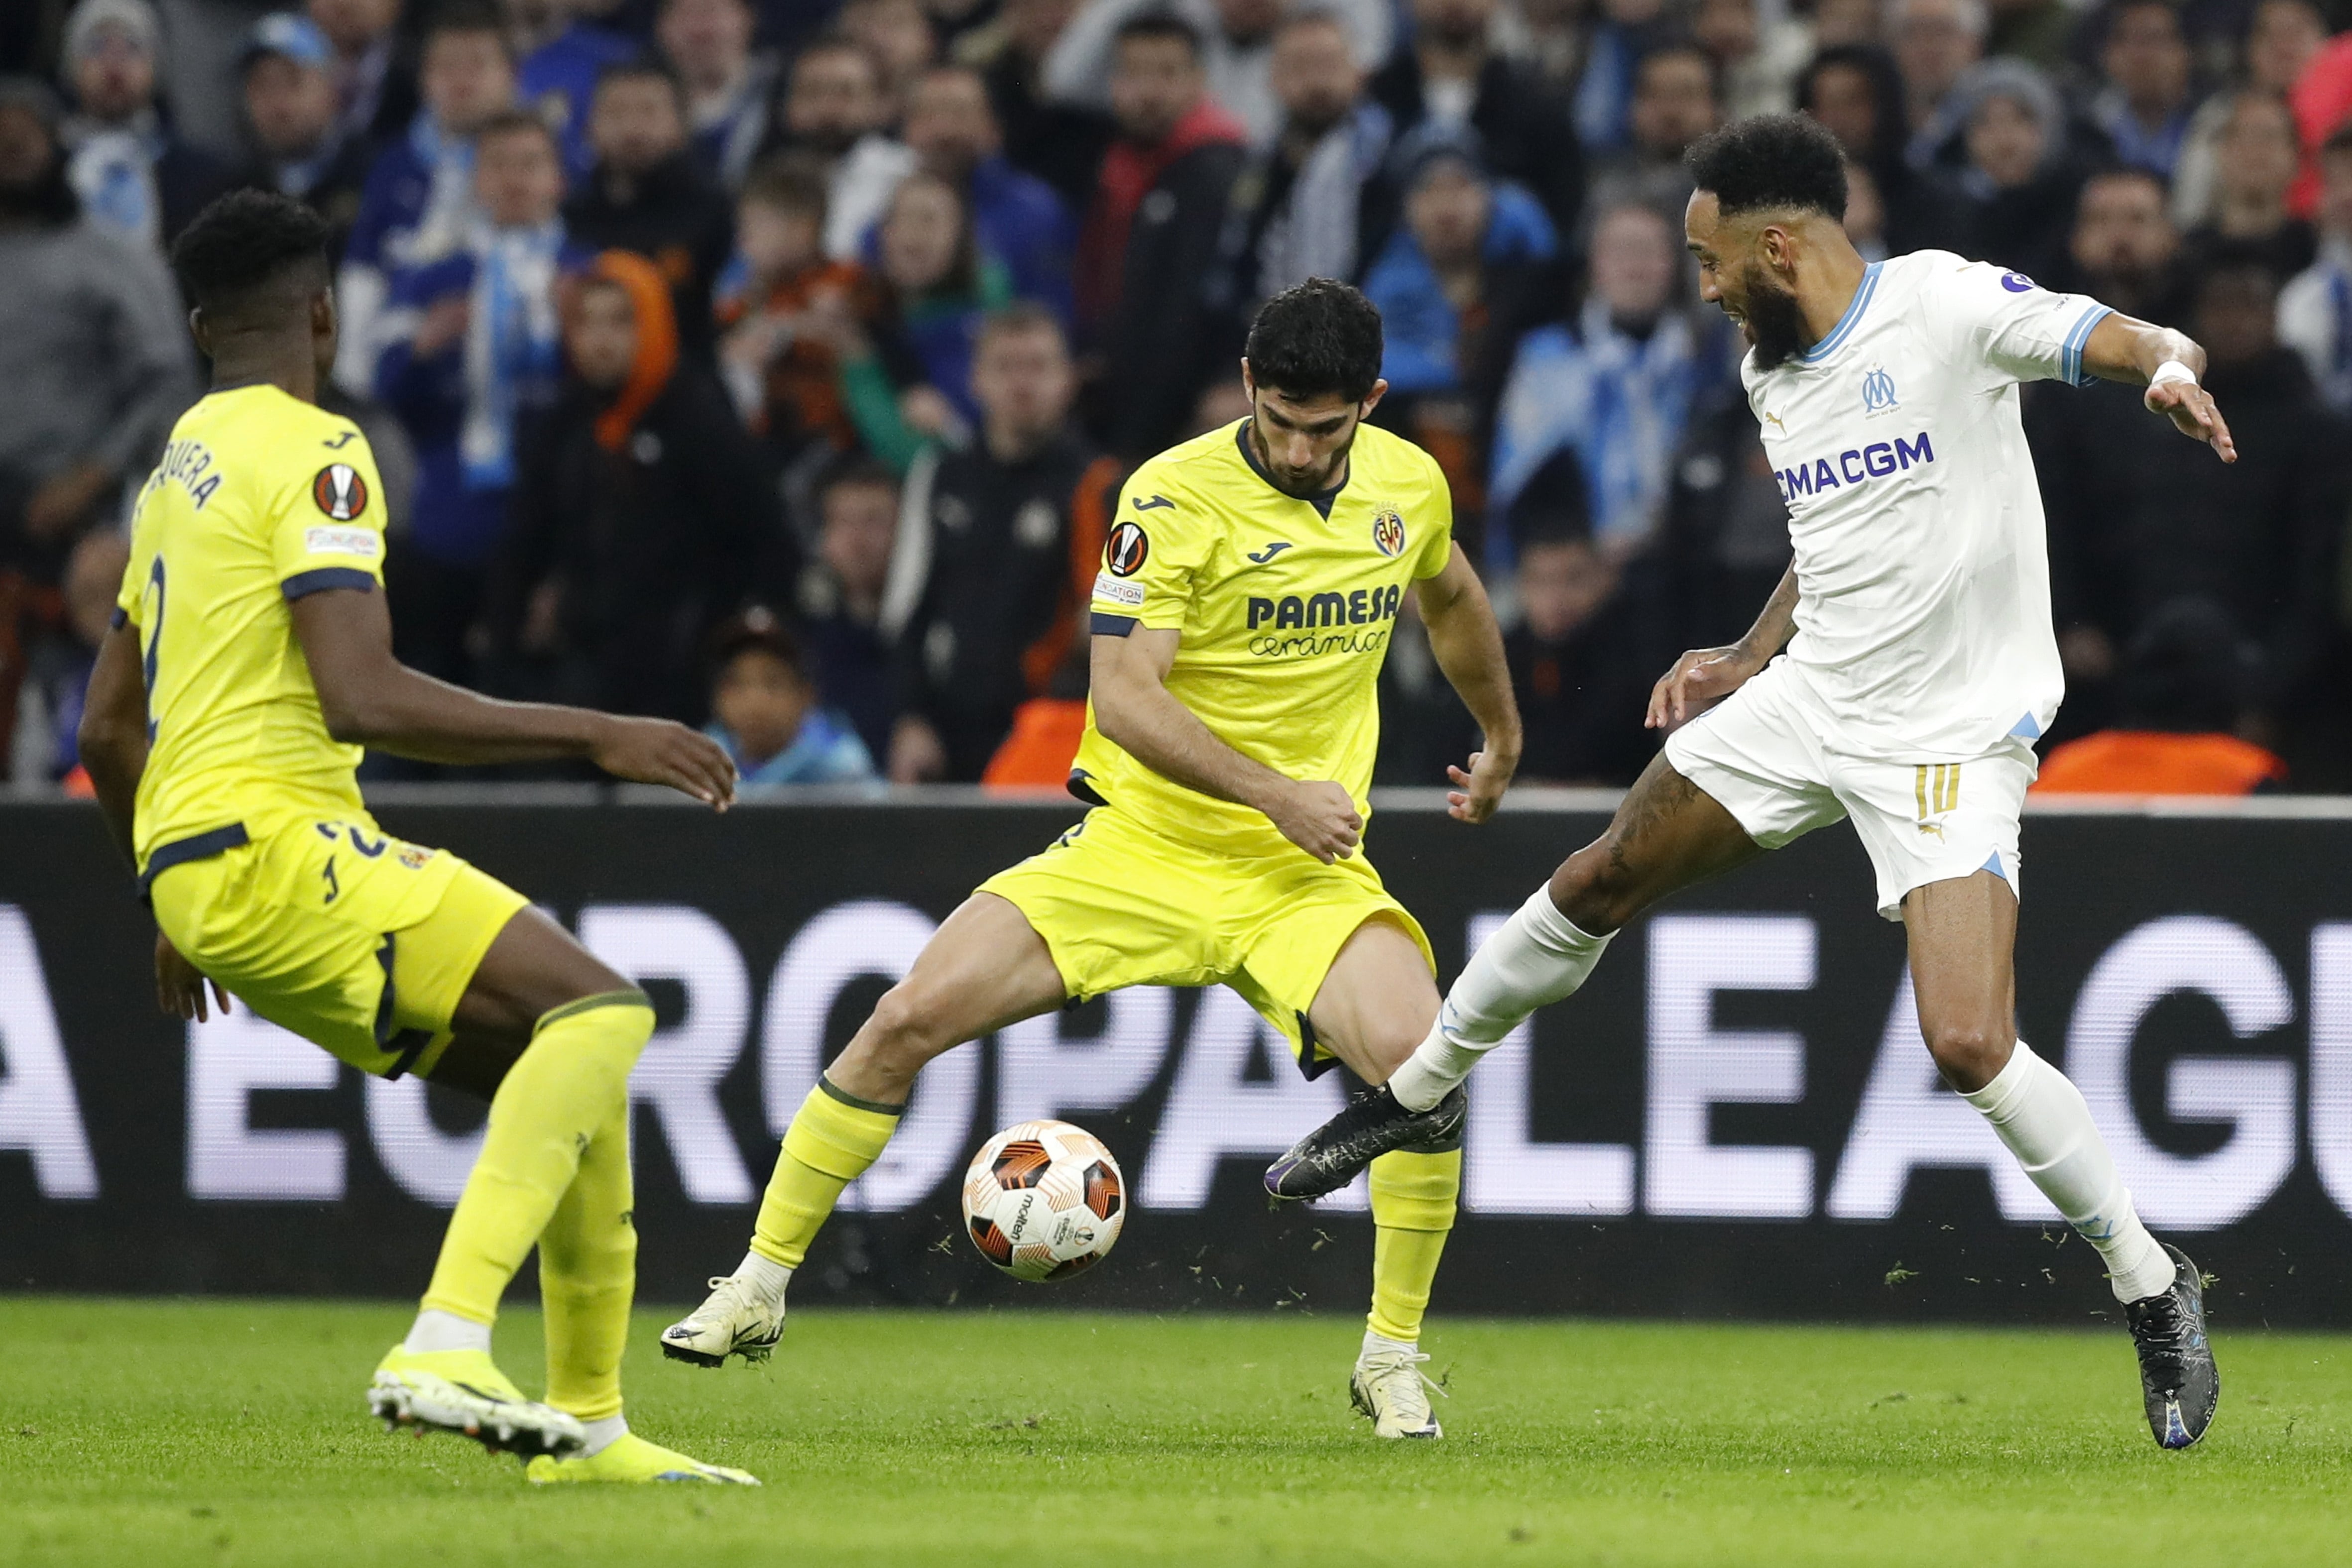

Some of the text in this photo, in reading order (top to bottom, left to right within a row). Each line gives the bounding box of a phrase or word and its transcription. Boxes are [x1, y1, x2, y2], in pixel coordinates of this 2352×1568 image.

[136, 442, 220, 518] QUERA
[1247, 584, 1400, 629] PAMESA
[1464, 912, 2352, 1231] LEAG
[1011, 1194, 1033, 1241] molten
